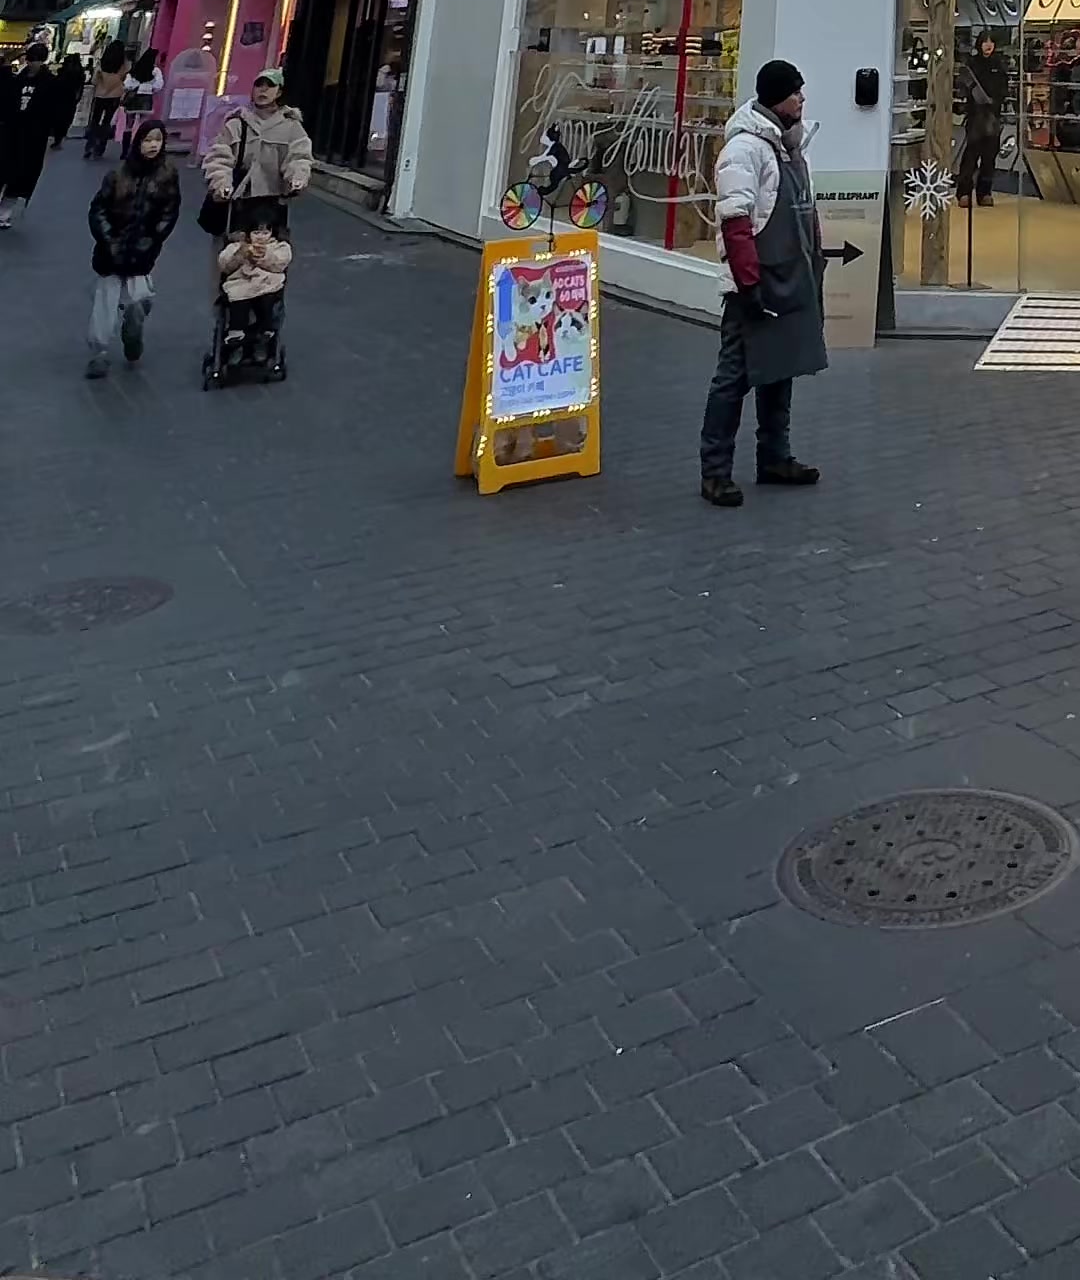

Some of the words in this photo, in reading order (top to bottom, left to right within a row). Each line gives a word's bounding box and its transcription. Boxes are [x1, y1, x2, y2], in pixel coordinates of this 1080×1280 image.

[815, 192, 836, 201] BLUE
[838, 191, 880, 201] ELEPHANT
[500, 362, 534, 383] CAT
[538, 354, 584, 377] CAFE
